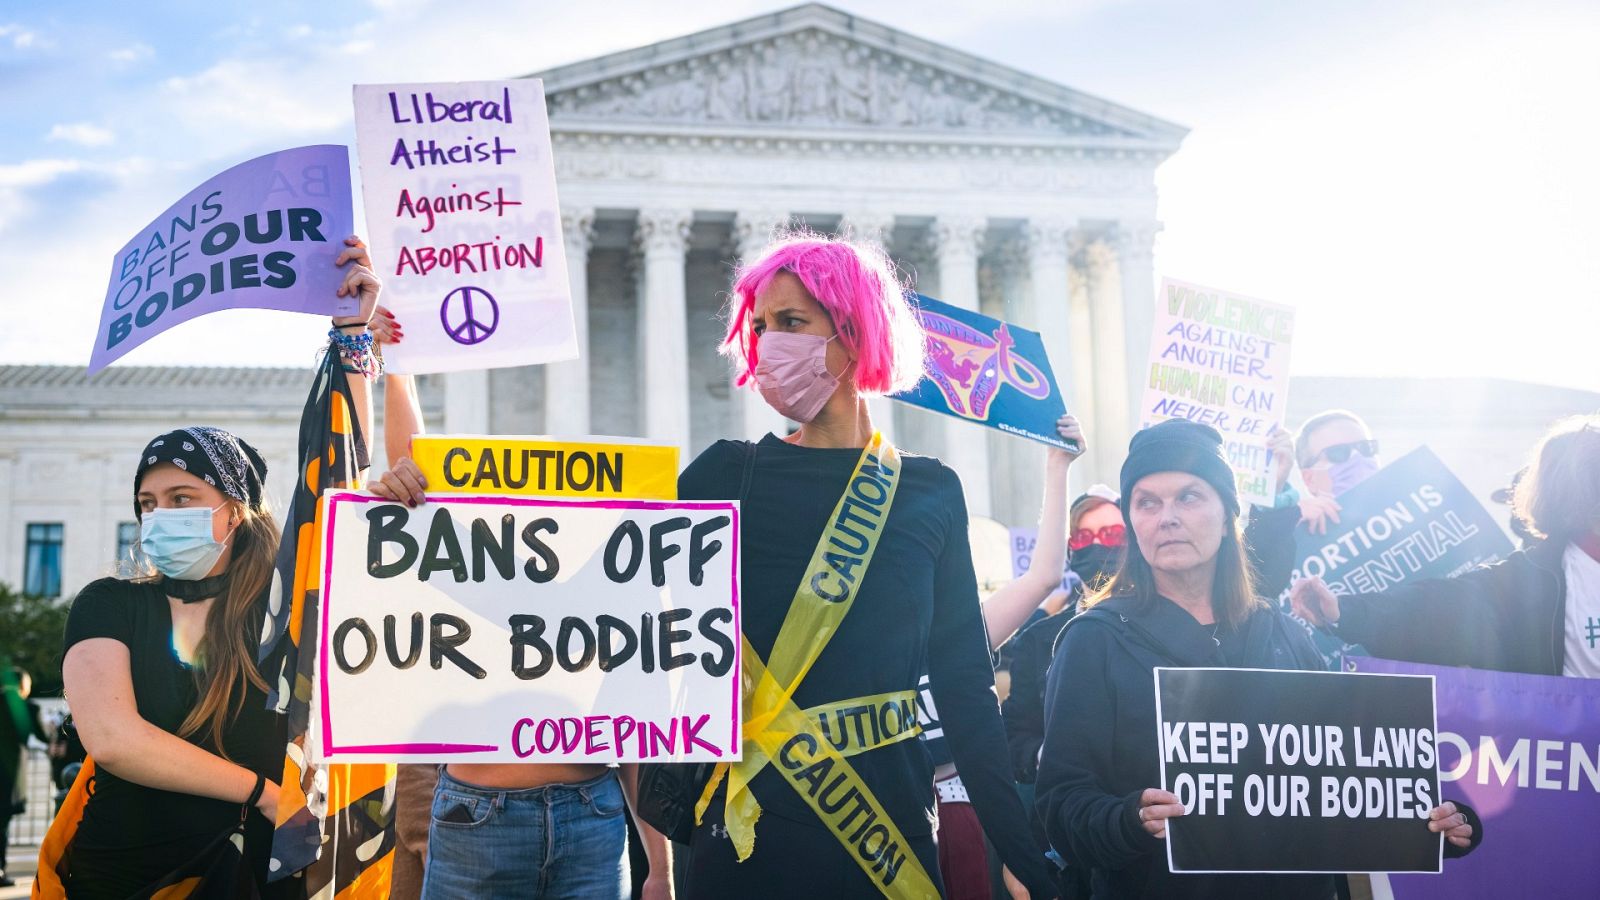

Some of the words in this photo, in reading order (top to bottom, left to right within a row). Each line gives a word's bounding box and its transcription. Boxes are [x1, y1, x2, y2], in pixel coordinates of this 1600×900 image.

[390, 135, 516, 170] Atheist
[396, 184, 521, 233] Against
[113, 240, 191, 310] OFF
[201, 207, 327, 255] OUR
[120, 190, 223, 282] BANS
[106, 251, 296, 350] BODIES
[1167, 284, 1295, 344] VIOLENCE
[1162, 341, 1272, 380] ANOTHER
[1167, 321, 1276, 359] AGAINST
[1149, 363, 1227, 406] HUMAN
[1232, 384, 1274, 412] CAN
[1152, 398, 1231, 431] NEVER
[1237, 416, 1261, 436] BE
[443, 447, 624, 492] CAUTION
[366, 505, 559, 583] BANS
[603, 514, 731, 587] OFF
[810, 453, 895, 603] CAUTION
[1278, 501, 1415, 607] ORTION
[1410, 484, 1443, 513] IS
[332, 611, 488, 680] OUR
[509, 607, 733, 680] BODIES
[512, 714, 723, 759] CODEPINK
[818, 698, 918, 751] UTION
[1163, 721, 1249, 764] KEEP
[1258, 723, 1346, 768] YOUR
[1353, 726, 1436, 770] LAWS
[1437, 731, 1600, 793] OMEN
[779, 732, 906, 887] CAUTION
[1174, 773, 1233, 817] OFF
[1244, 773, 1311, 818] OUR
[1321, 776, 1434, 820] BODIES
